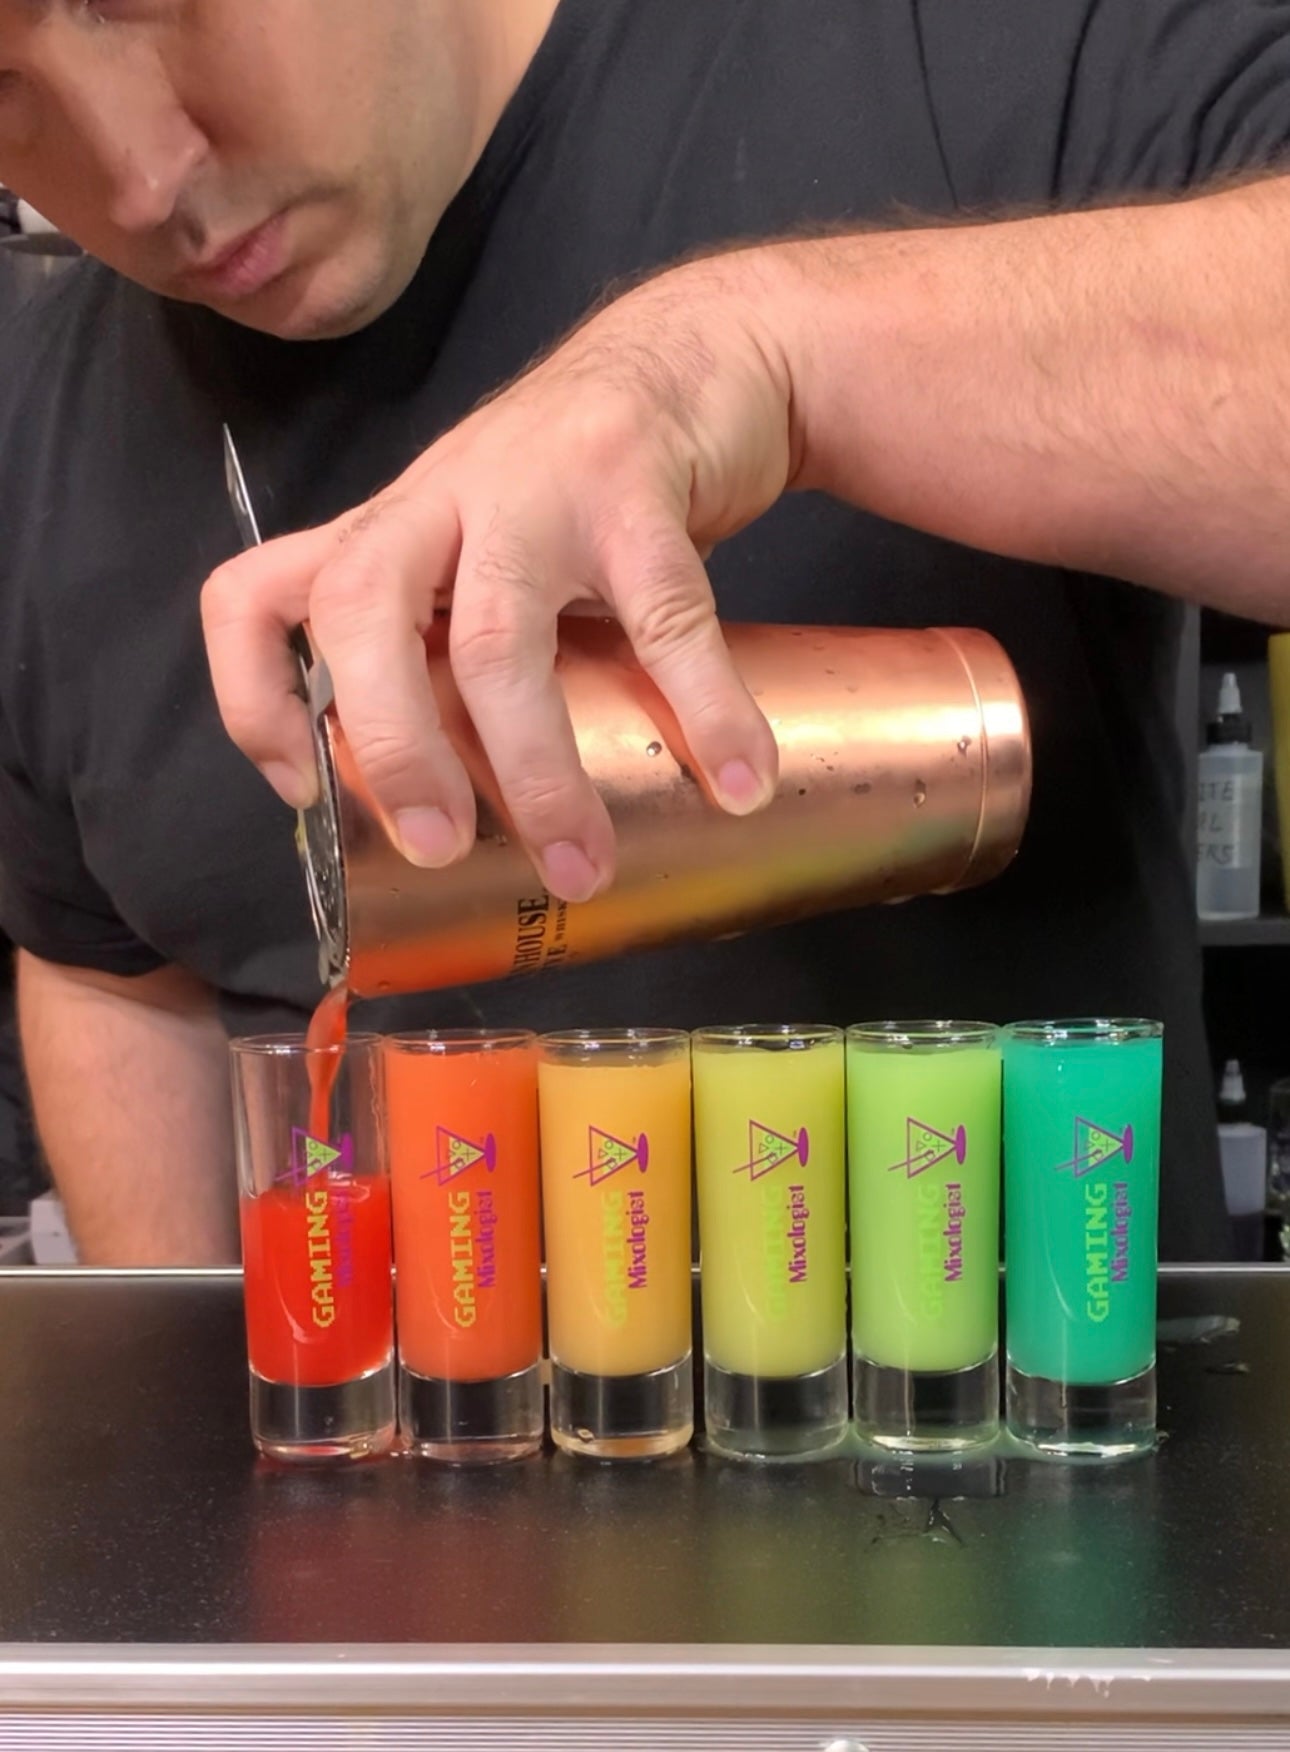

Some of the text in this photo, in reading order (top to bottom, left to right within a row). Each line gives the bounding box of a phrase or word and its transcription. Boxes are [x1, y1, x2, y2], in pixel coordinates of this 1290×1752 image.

[555, 898, 568, 942] WHISK
[305, 1191, 335, 1328] GAMING
[448, 1191, 477, 1328] GAMING
[474, 1190, 498, 1288] Mixologist
[625, 1190, 650, 1289] Mixologist
[786, 1185, 810, 1283] Mixologist
[942, 1183, 966, 1282] Mixologist
[1085, 1183, 1110, 1323] GAMING
[1109, 1183, 1132, 1282] Mixologist
